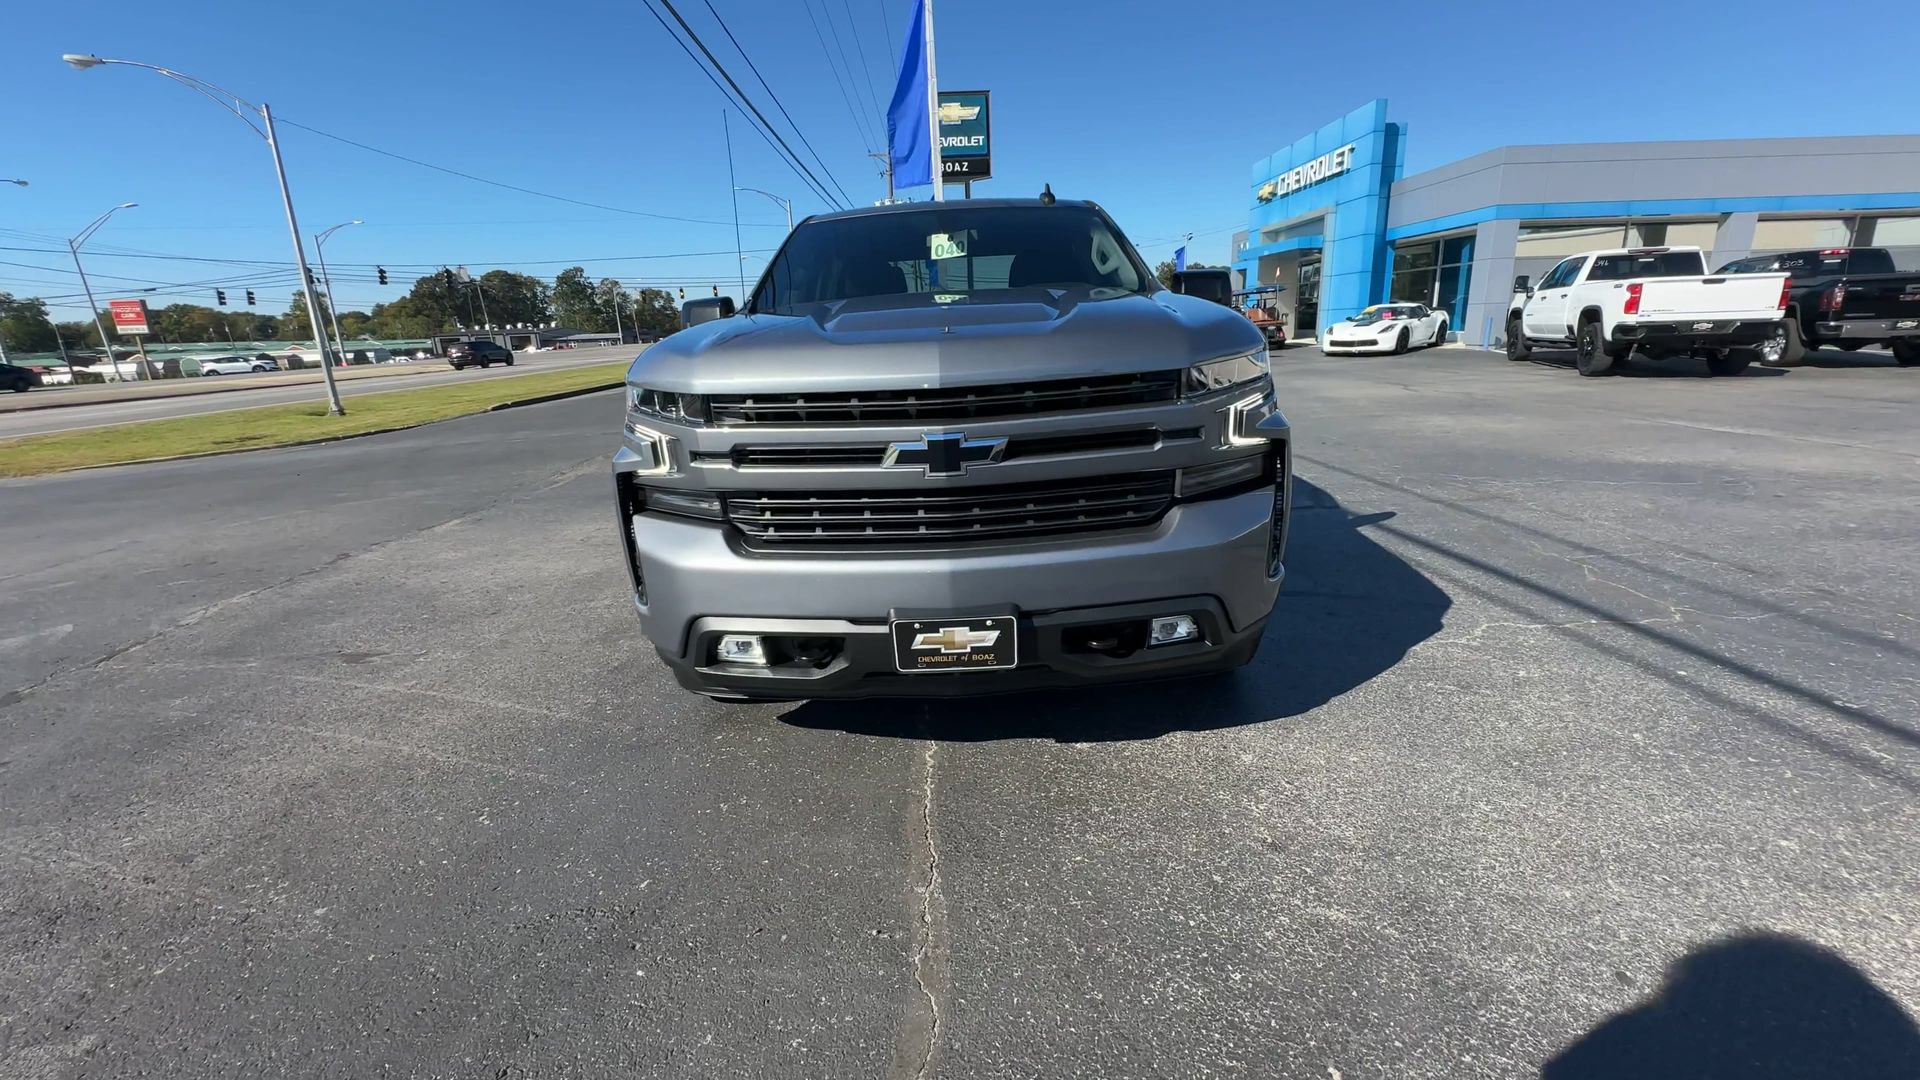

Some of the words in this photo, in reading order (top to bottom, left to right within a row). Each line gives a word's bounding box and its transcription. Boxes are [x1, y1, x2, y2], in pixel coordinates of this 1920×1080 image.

[939, 136, 984, 147] EVROLET
[1277, 143, 1355, 196] CHEVROLET
[917, 655, 958, 663] CHEVROLET
[961, 653, 969, 662] of
[972, 653, 995, 661] BOAZ
